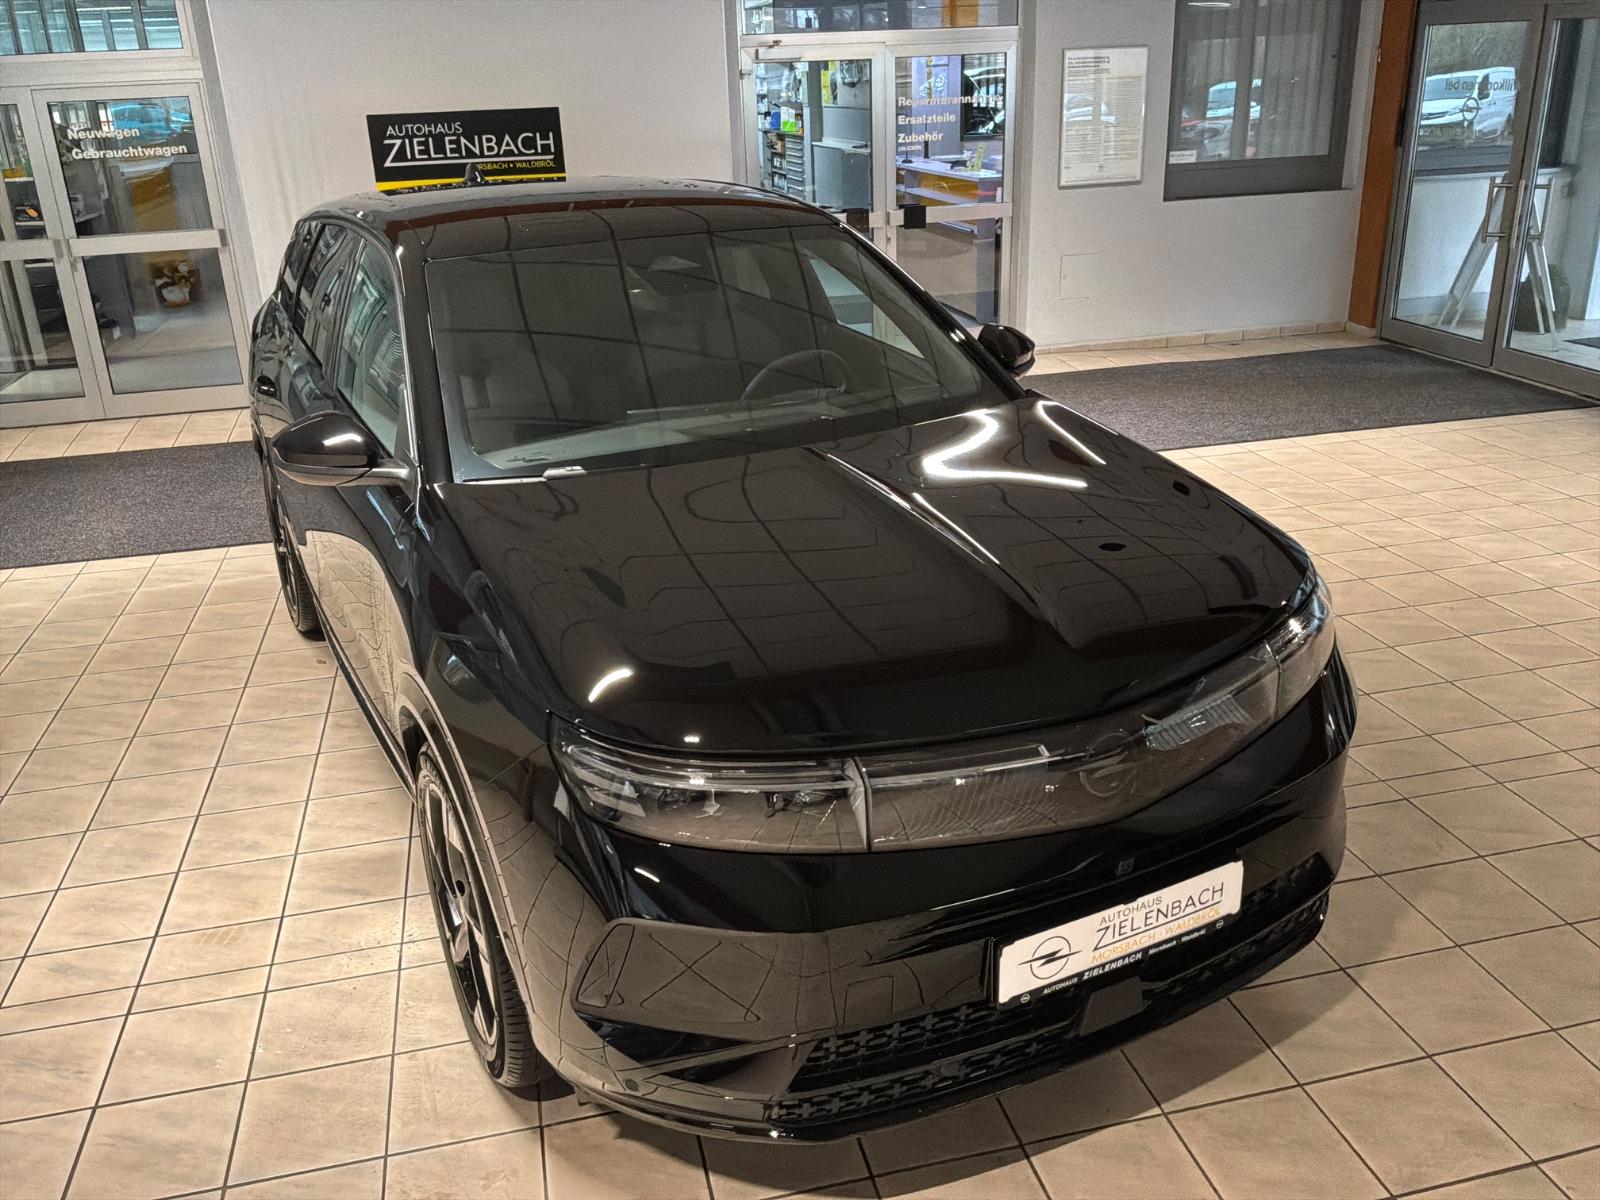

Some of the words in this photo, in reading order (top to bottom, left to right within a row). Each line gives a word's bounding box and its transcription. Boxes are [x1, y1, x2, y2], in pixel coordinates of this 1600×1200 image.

[898, 113, 956, 125] Ersatzteile
[67, 127, 140, 140] Neuwagen
[386, 122, 463, 137] AUTOHAUS
[898, 131, 944, 143] Zubehör
[72, 144, 188, 160] Gebrauchtwagen
[383, 132, 555, 167] ZIELENBACH
[514, 160, 556, 169] WALDBRÖL
[1093, 882, 1225, 951] ZIELENBACH
[1099, 897, 1163, 926] AUTOHAUS
[1091, 932, 1156, 963] MORSBACH
[1165, 907, 1221, 937] WALDBRÖL
[1042, 977, 1078, 994] AUTOHAUS
[1083, 953, 1142, 980] ZIELENBACH
